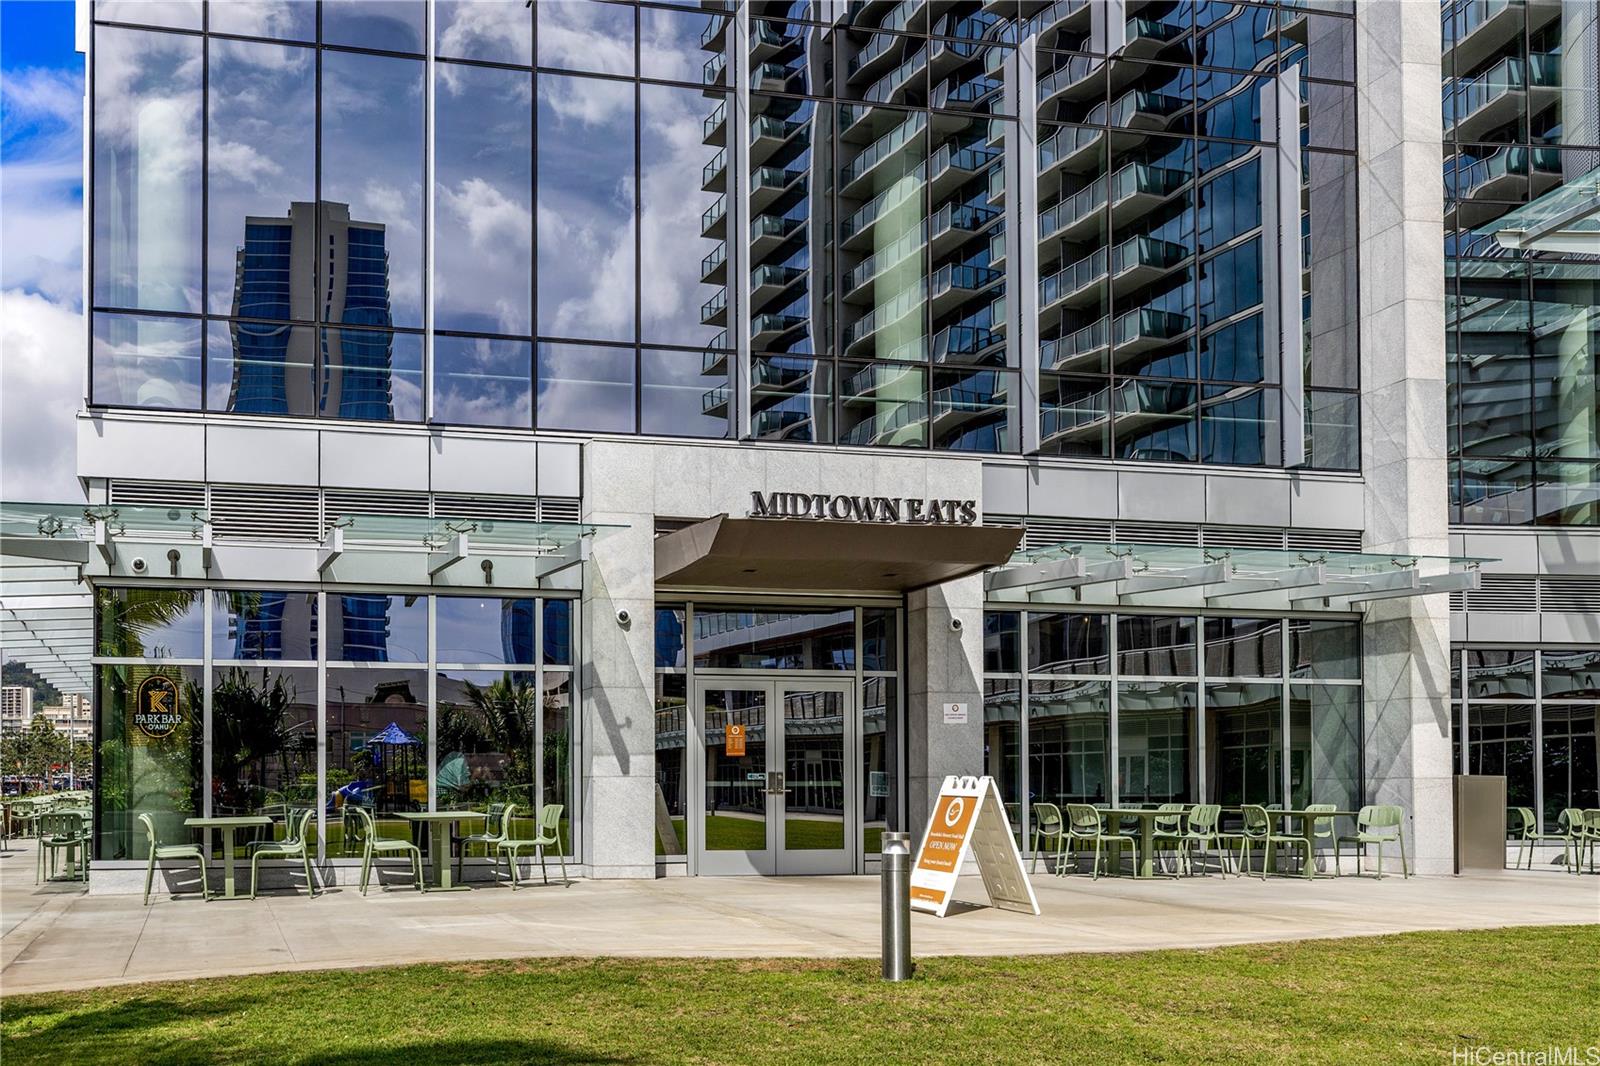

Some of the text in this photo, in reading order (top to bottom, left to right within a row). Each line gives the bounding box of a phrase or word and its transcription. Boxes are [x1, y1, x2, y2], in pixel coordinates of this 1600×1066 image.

[752, 491, 977, 525] MIDTOWN EATS
[135, 715, 181, 723] PARK BAR
[929, 840, 957, 850] OPEN NOW
